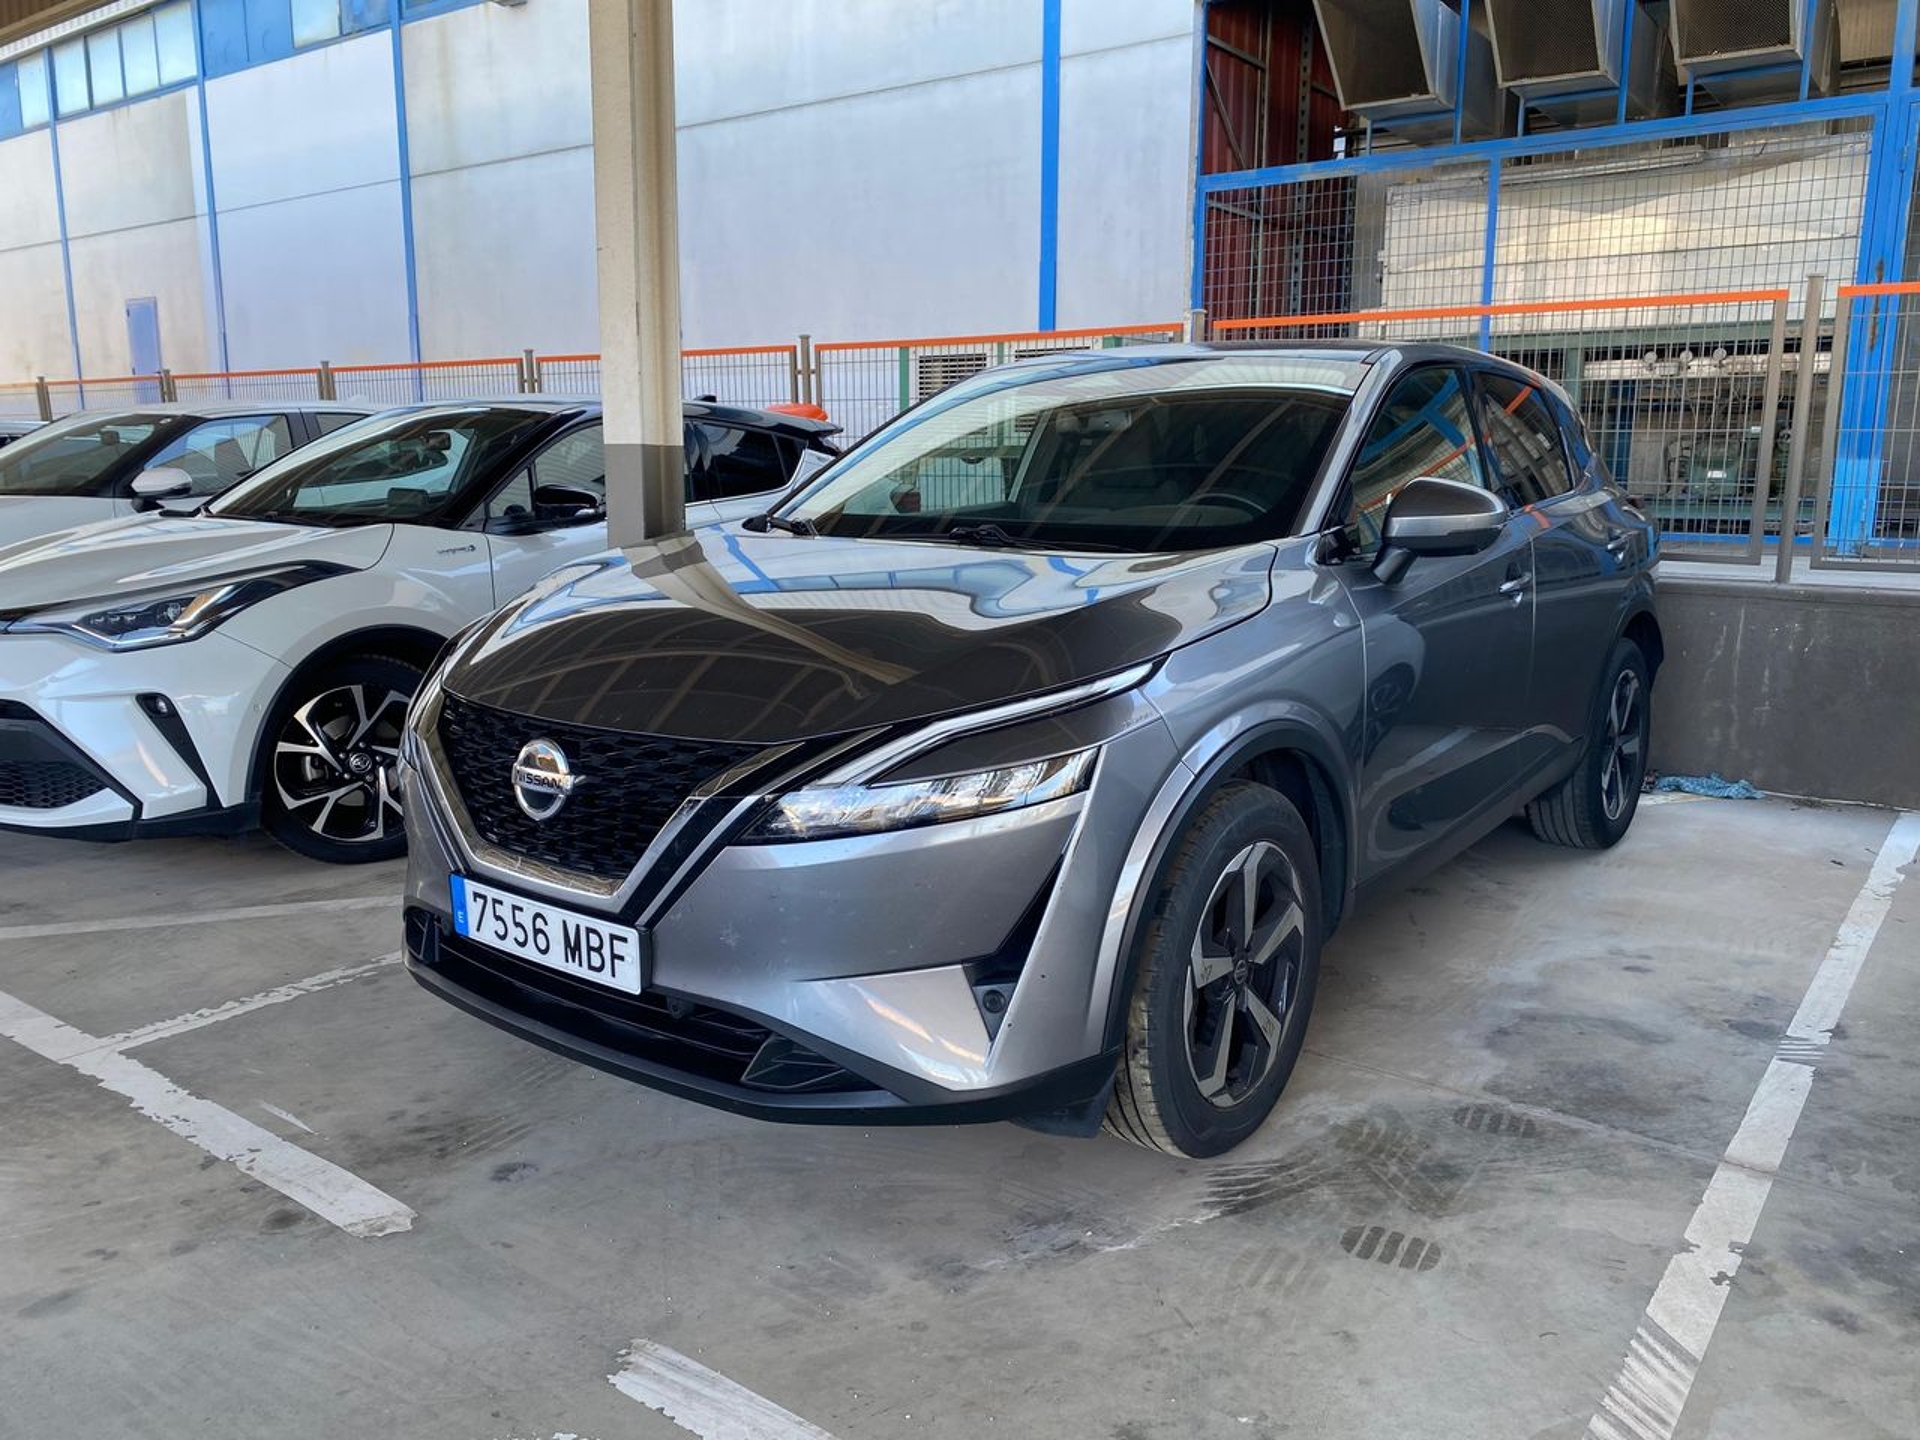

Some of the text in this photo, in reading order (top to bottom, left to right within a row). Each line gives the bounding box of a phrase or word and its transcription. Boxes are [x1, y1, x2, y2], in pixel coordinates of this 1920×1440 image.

[517, 770, 562, 790] NISSAN
[472, 891, 628, 978] 7556 MBF
